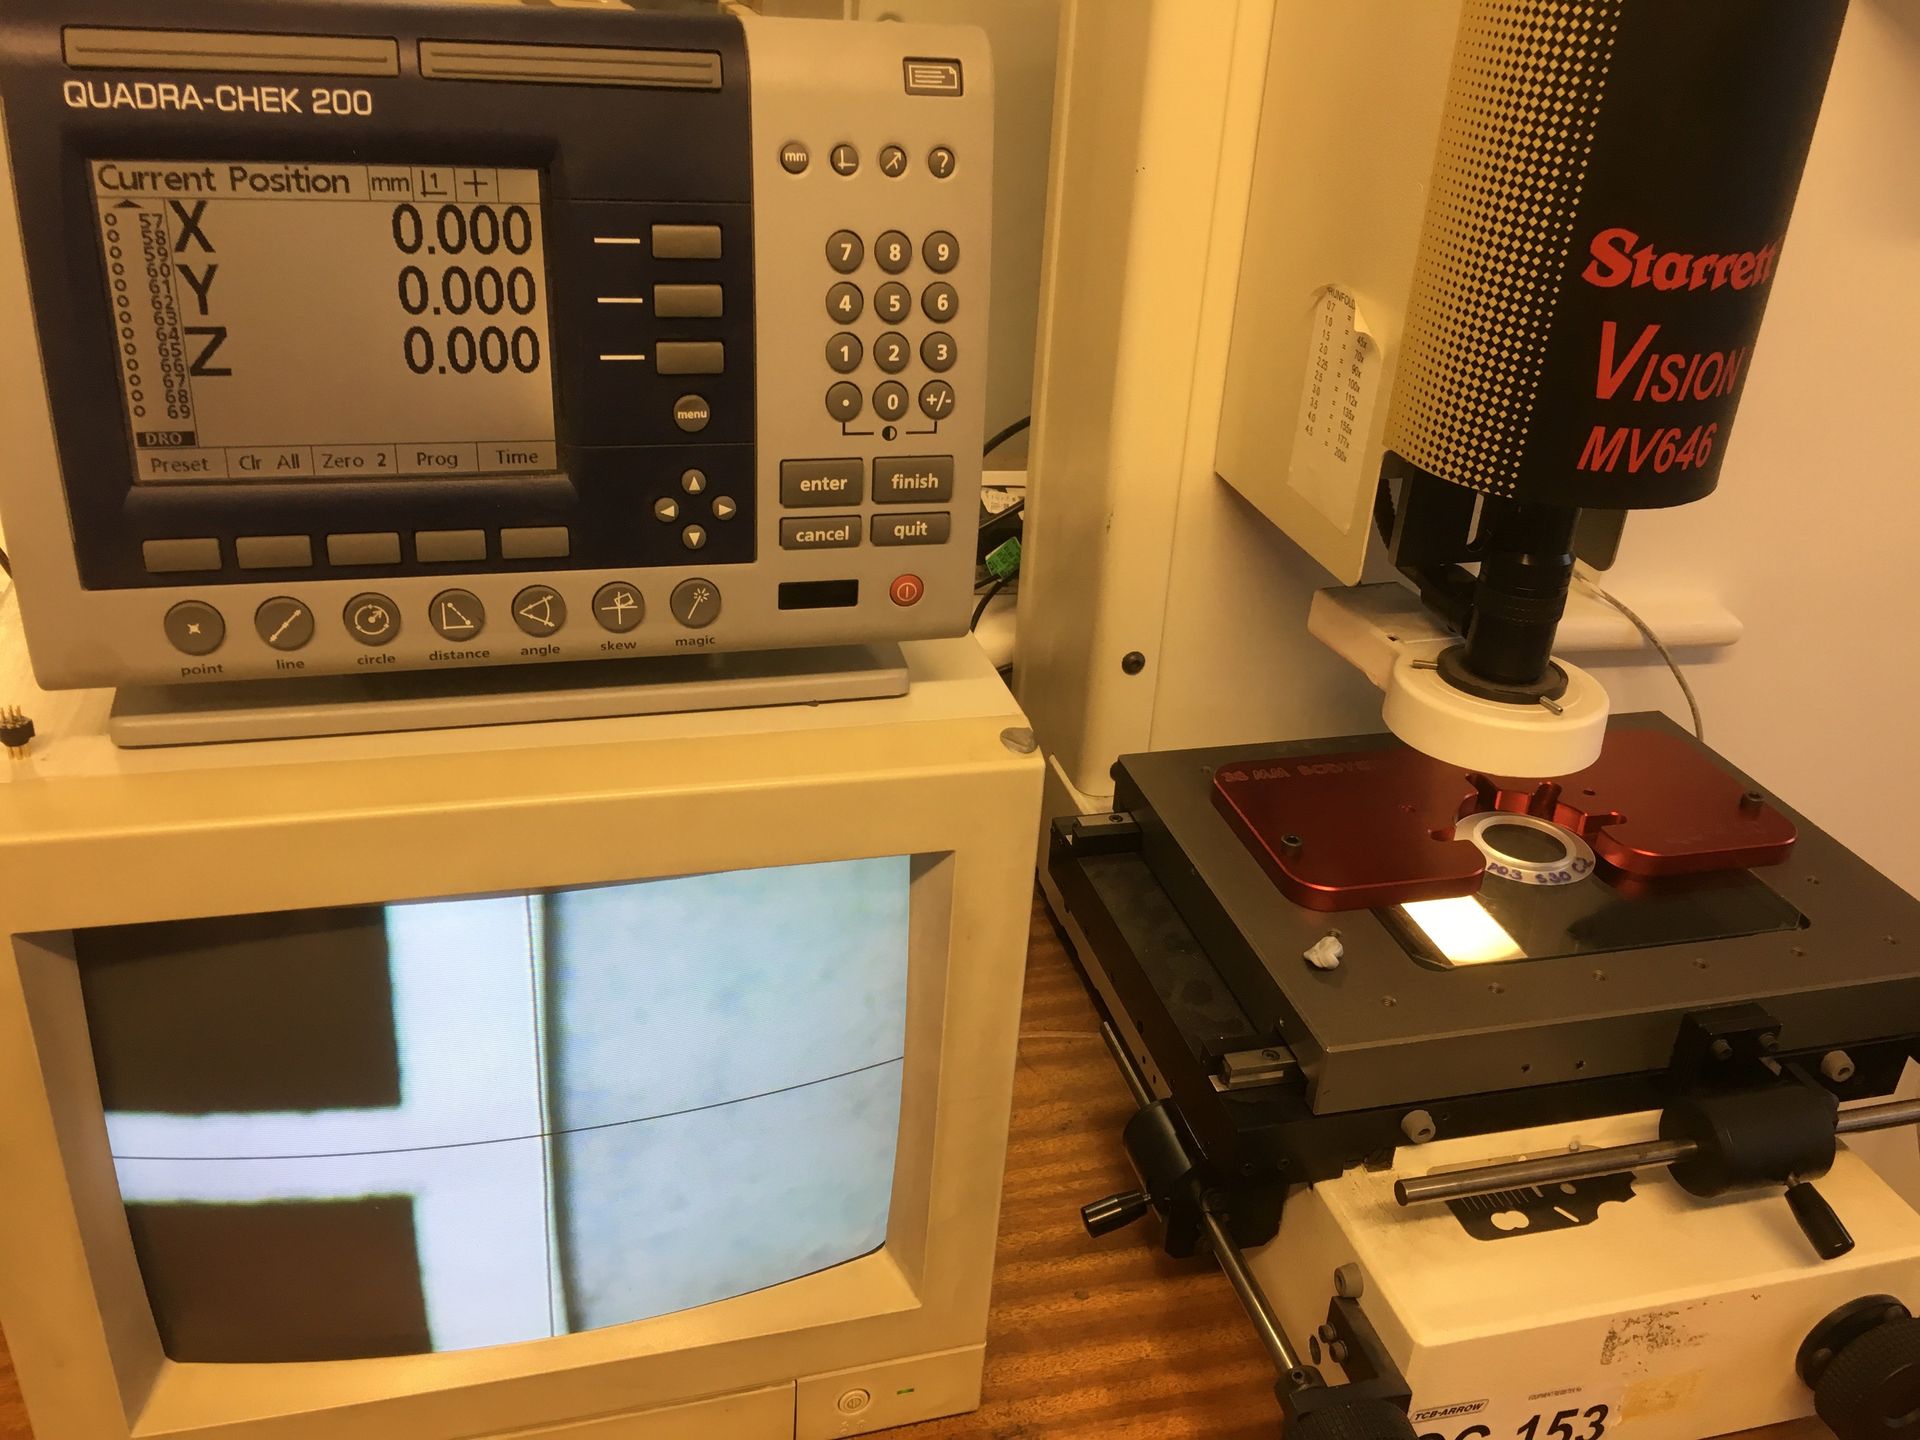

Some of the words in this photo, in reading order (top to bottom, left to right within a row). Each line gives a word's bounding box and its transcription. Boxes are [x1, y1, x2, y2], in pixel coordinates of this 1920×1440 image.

[63, 80, 302, 113] QUADRA-CHEK
[312, 88, 373, 116] 200
[785, 152, 806, 162] mm
[98, 164, 217, 193] Current
[229, 165, 350, 194] Position
[371, 175, 410, 192] mm
[139, 212, 162, 229] 57
[168, 199, 217, 253] X
[392, 203, 532, 255] 0.000
[142, 230, 166, 246] 58
[145, 246, 168, 262] 59
[841, 244, 852, 261] 7
[889, 244, 901, 261] 8
[937, 243, 949, 260] 9
[147, 262, 170, 278] 60
[149, 279, 170, 294] 61
[174, 264, 218, 315] Y
[398, 265, 536, 315] 0.000
[151, 294, 174, 310] 62
[839, 295, 851, 312] 4
[889, 295, 900, 312] 5
[937, 294, 948, 311] 6
[154, 311, 177, 326] 63
[156, 327, 179, 341] 64
[158, 342, 182, 357] 65
[184, 326, 233, 376] Z
[404, 326, 540, 374] 0.000
[840, 345, 849, 362] 1
[888, 344, 899, 361] 2
[937, 344, 948, 360] 3
[161, 358, 184, 373] 66
[163, 374, 186, 388] 67
[165, 389, 188, 404] 68
[887, 394, 899, 410] 0
[926, 390, 952, 412] +/-
[167, 404, 190, 419] 69
[677, 409, 707, 420] menu
[146, 432, 182, 446] DRO
[1576, 422, 1718, 474] MV646
[151, 457, 210, 473] Preset
[239, 454, 262, 470] Clr
[276, 453, 300, 470] All
[322, 452, 364, 468] Zero
[377, 452, 387, 467] 2
[416, 451, 458, 468] Prog
[496, 450, 539, 464] Time
[800, 476, 848, 492] enter
[891, 473, 939, 489] finish
[796, 526, 850, 542] cancel
[894, 520, 928, 539] quit
[600, 639, 637, 651] skew
[675, 635, 716, 648] magic
[429, 648, 490, 662] distance
[520, 644, 561, 657] angle
[276, 659, 305, 670] line
[357, 653, 396, 665] circle
[181, 663, 224, 678] point
[1414, 1402, 1484, 1421] TCB-ARROW
